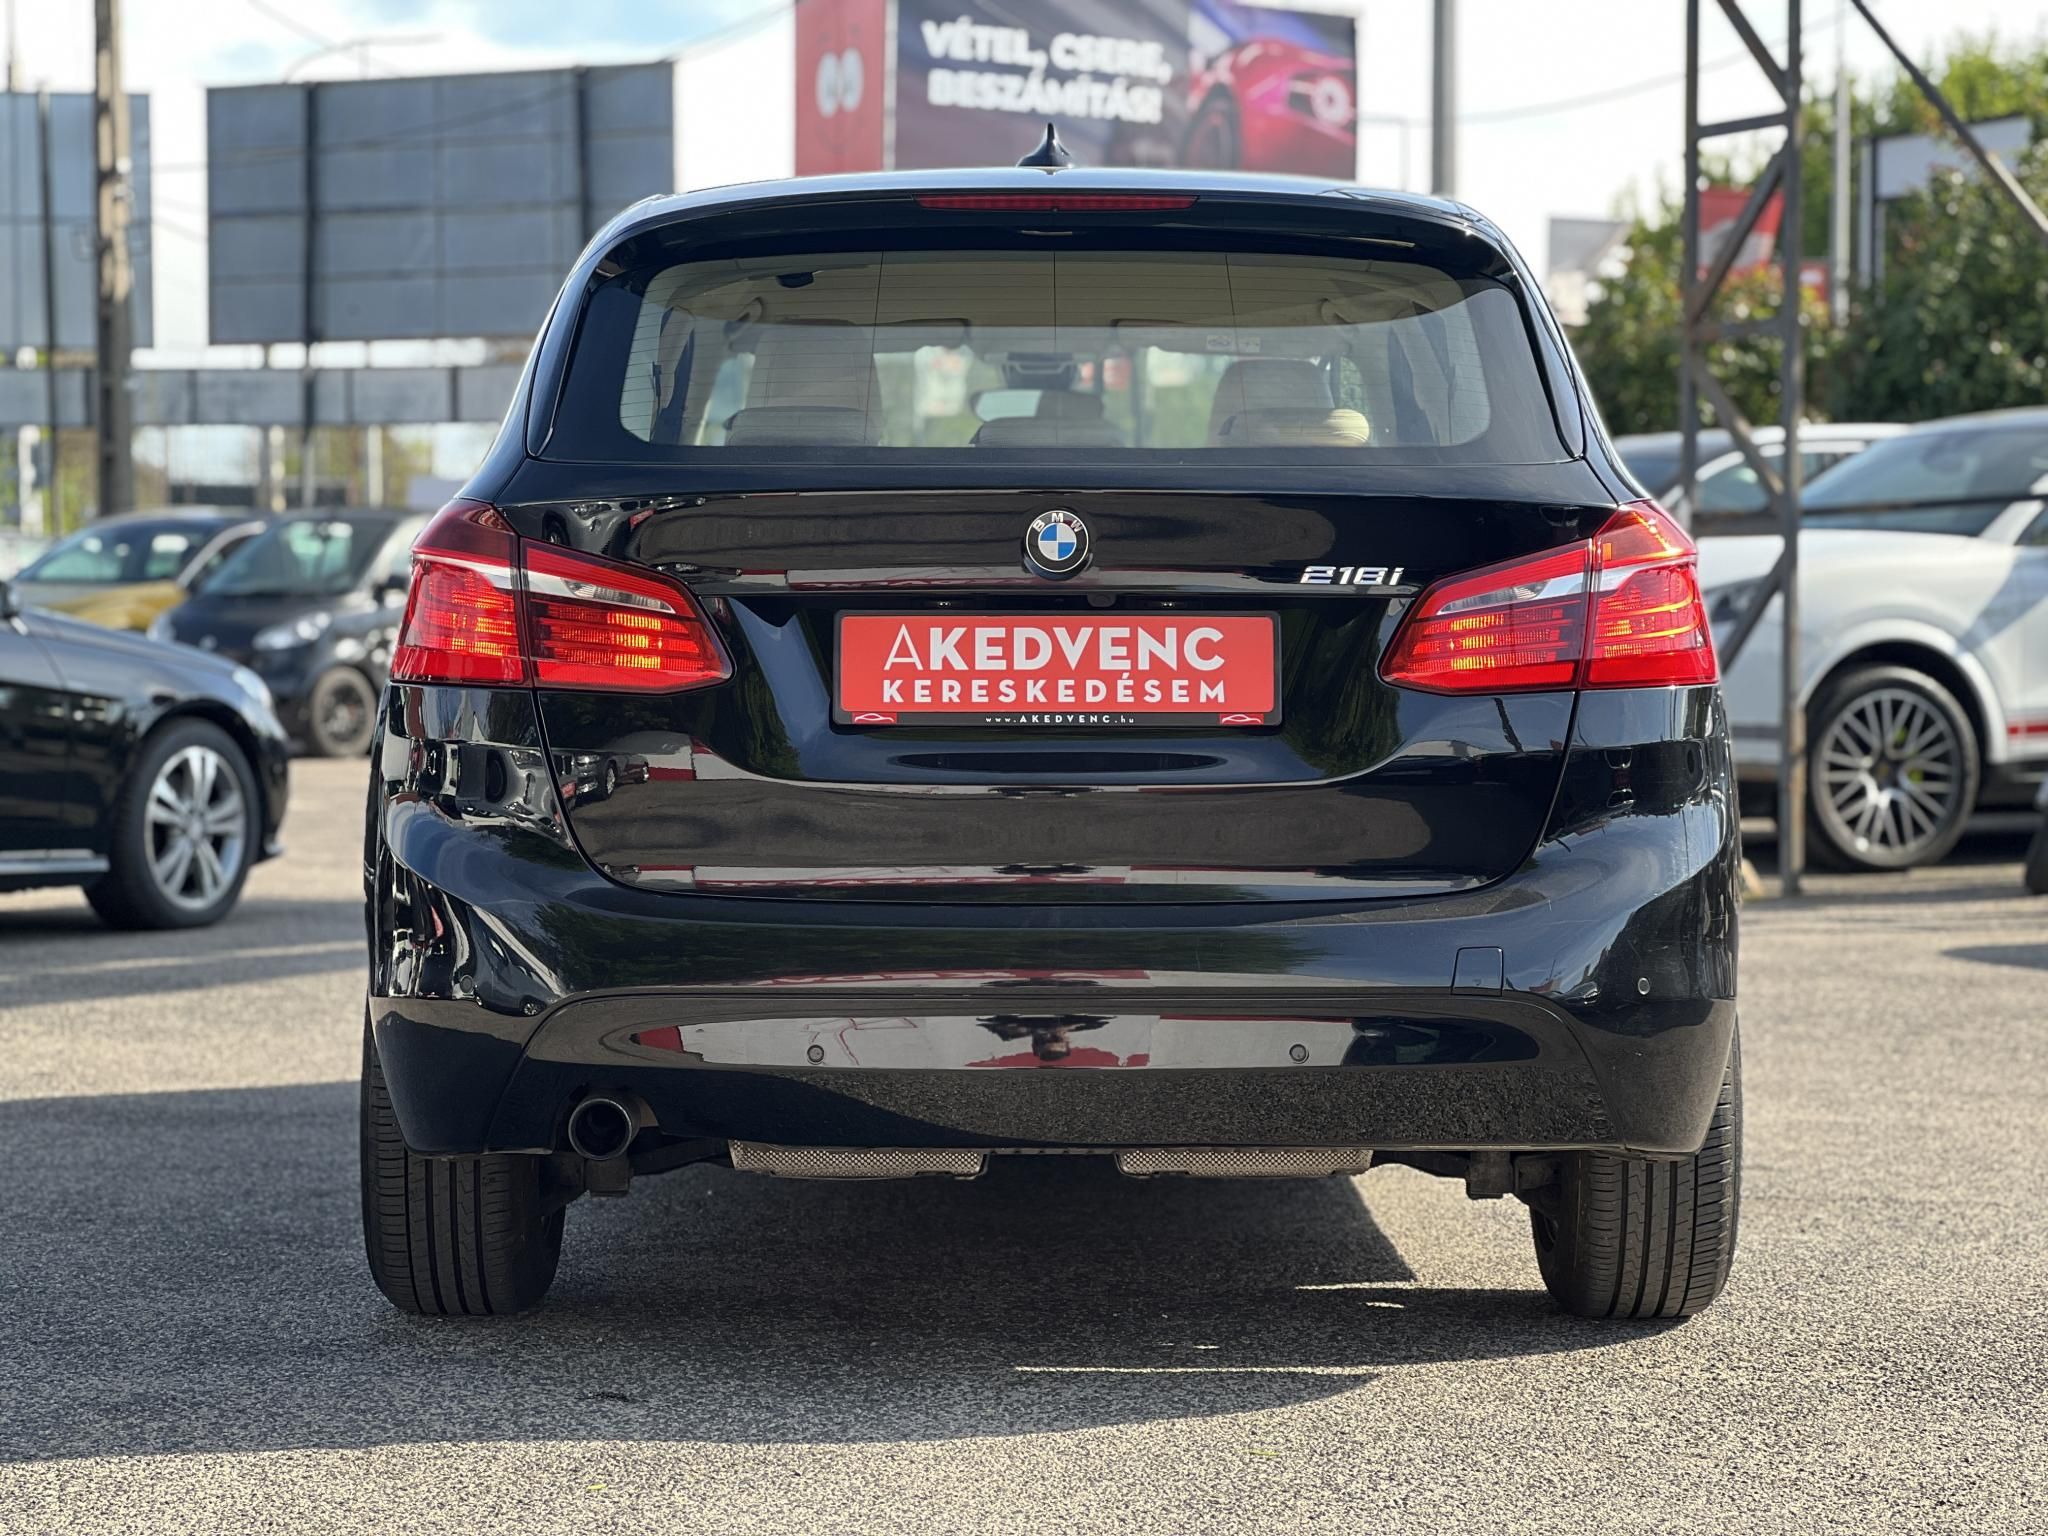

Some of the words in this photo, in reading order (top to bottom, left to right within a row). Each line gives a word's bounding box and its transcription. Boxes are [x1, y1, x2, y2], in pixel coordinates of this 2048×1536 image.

[920, 15, 1048, 69] VÉTEL,
[1032, 512, 1083, 532] BMW
[1300, 566, 1404, 585] 218i
[883, 673, 1225, 703] KERESKEDÉSEM
[985, 714, 1135, 724] www.AKEDVENC.hu
